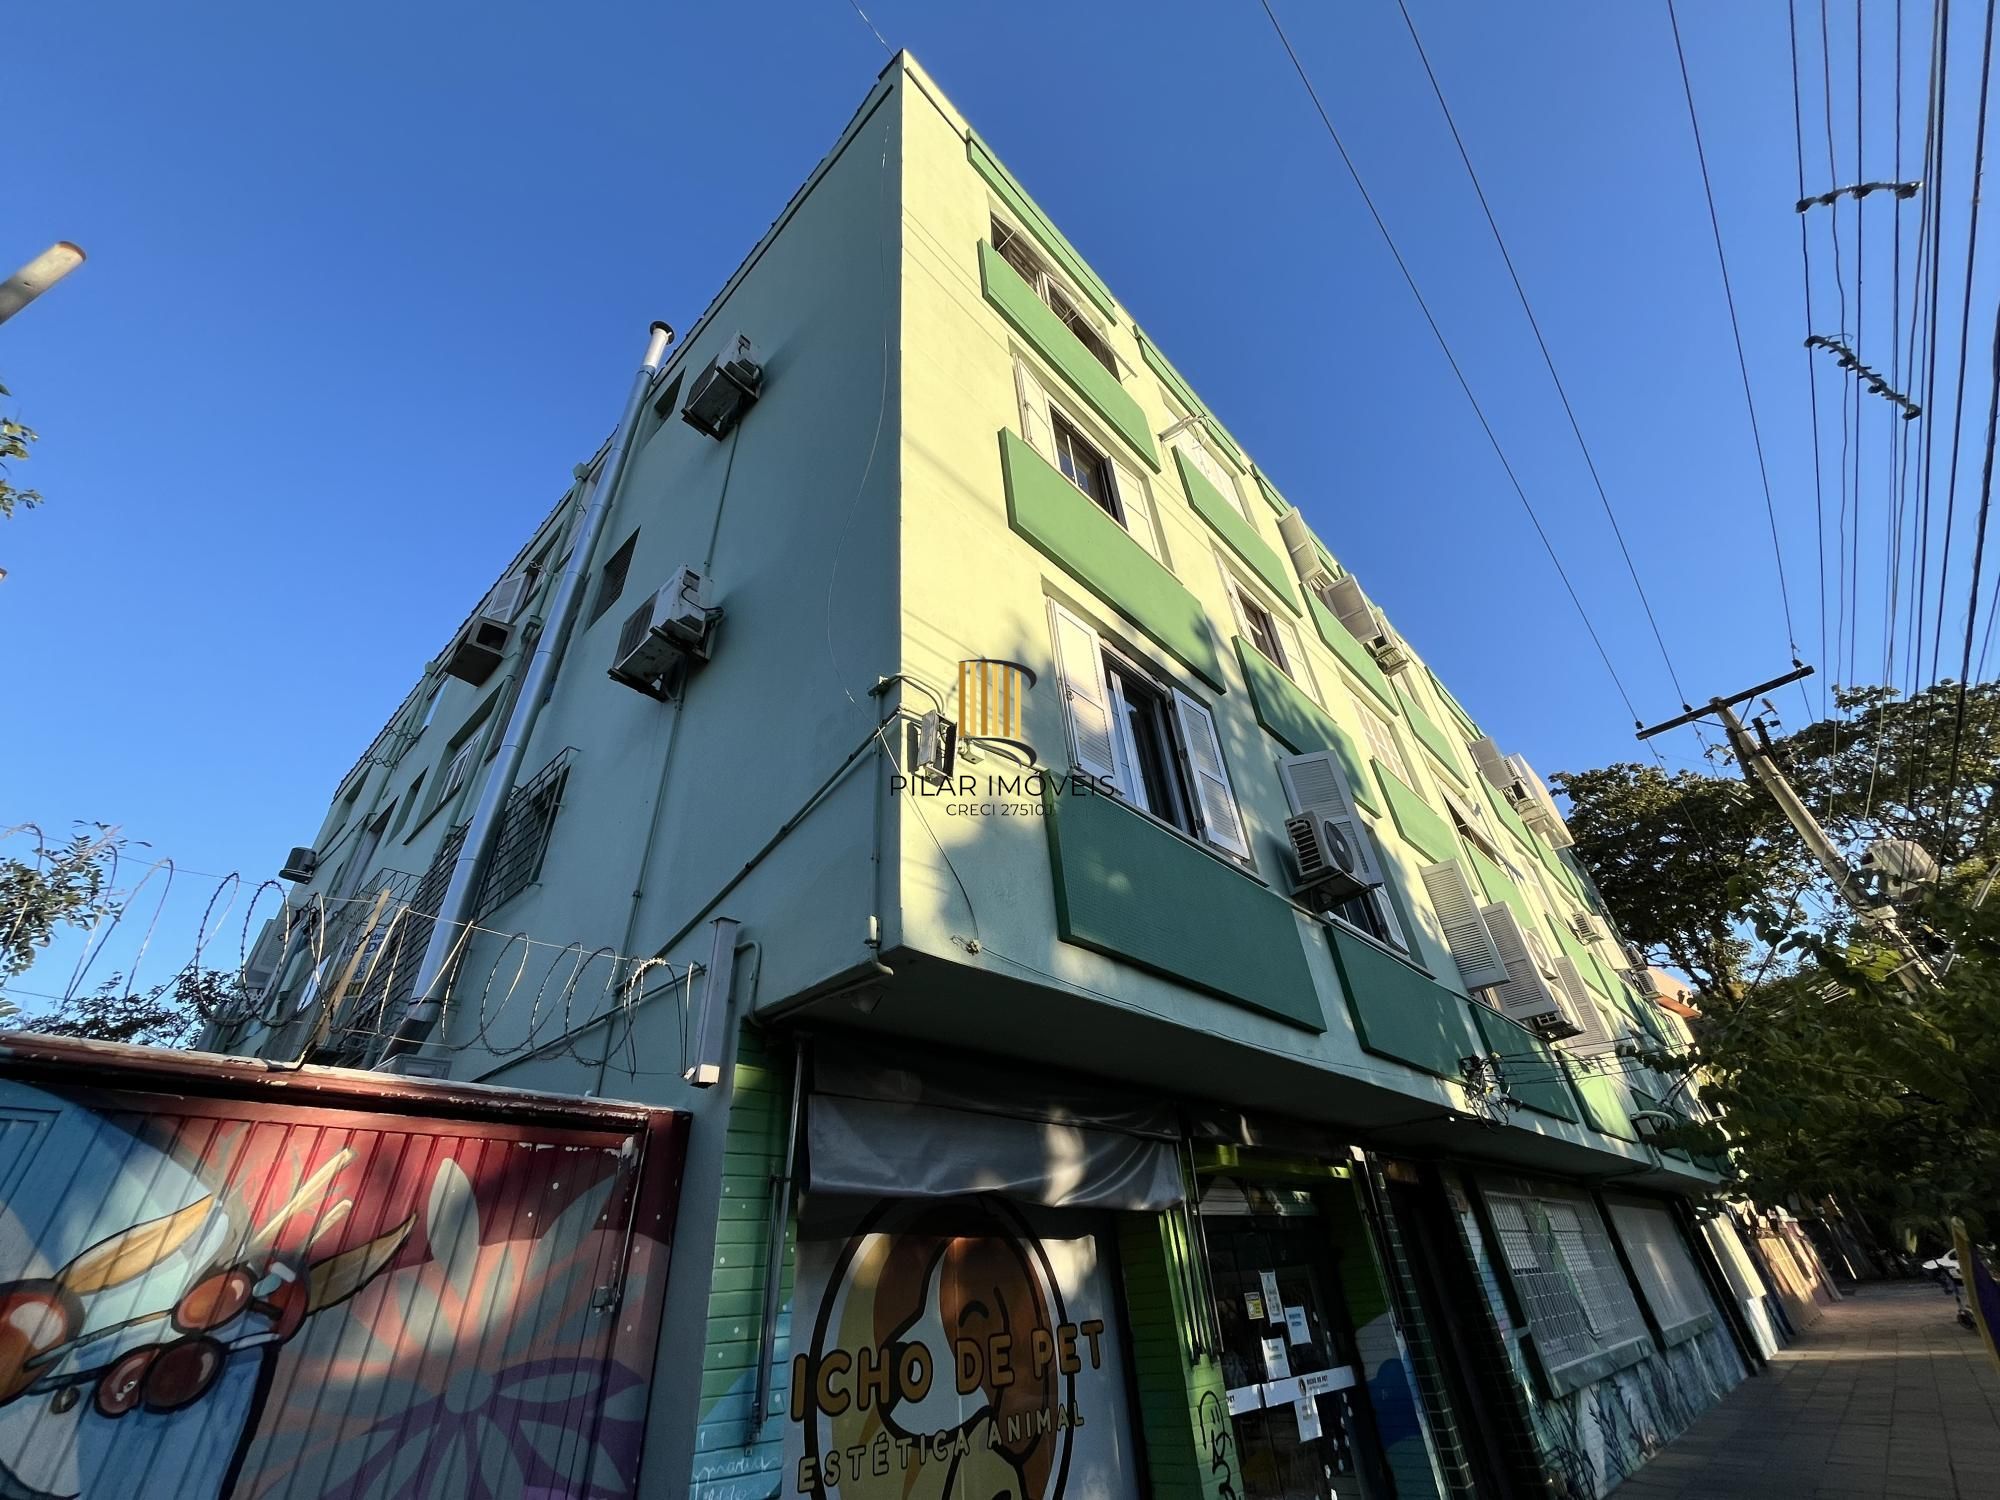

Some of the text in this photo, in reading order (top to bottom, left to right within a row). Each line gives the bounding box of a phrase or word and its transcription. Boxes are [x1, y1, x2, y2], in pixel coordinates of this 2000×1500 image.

[955, 1334, 1015, 1395] DE
[1030, 1319, 1104, 1381] PET
[797, 1401, 1084, 1493] ESTÉTICA ANIMAL
